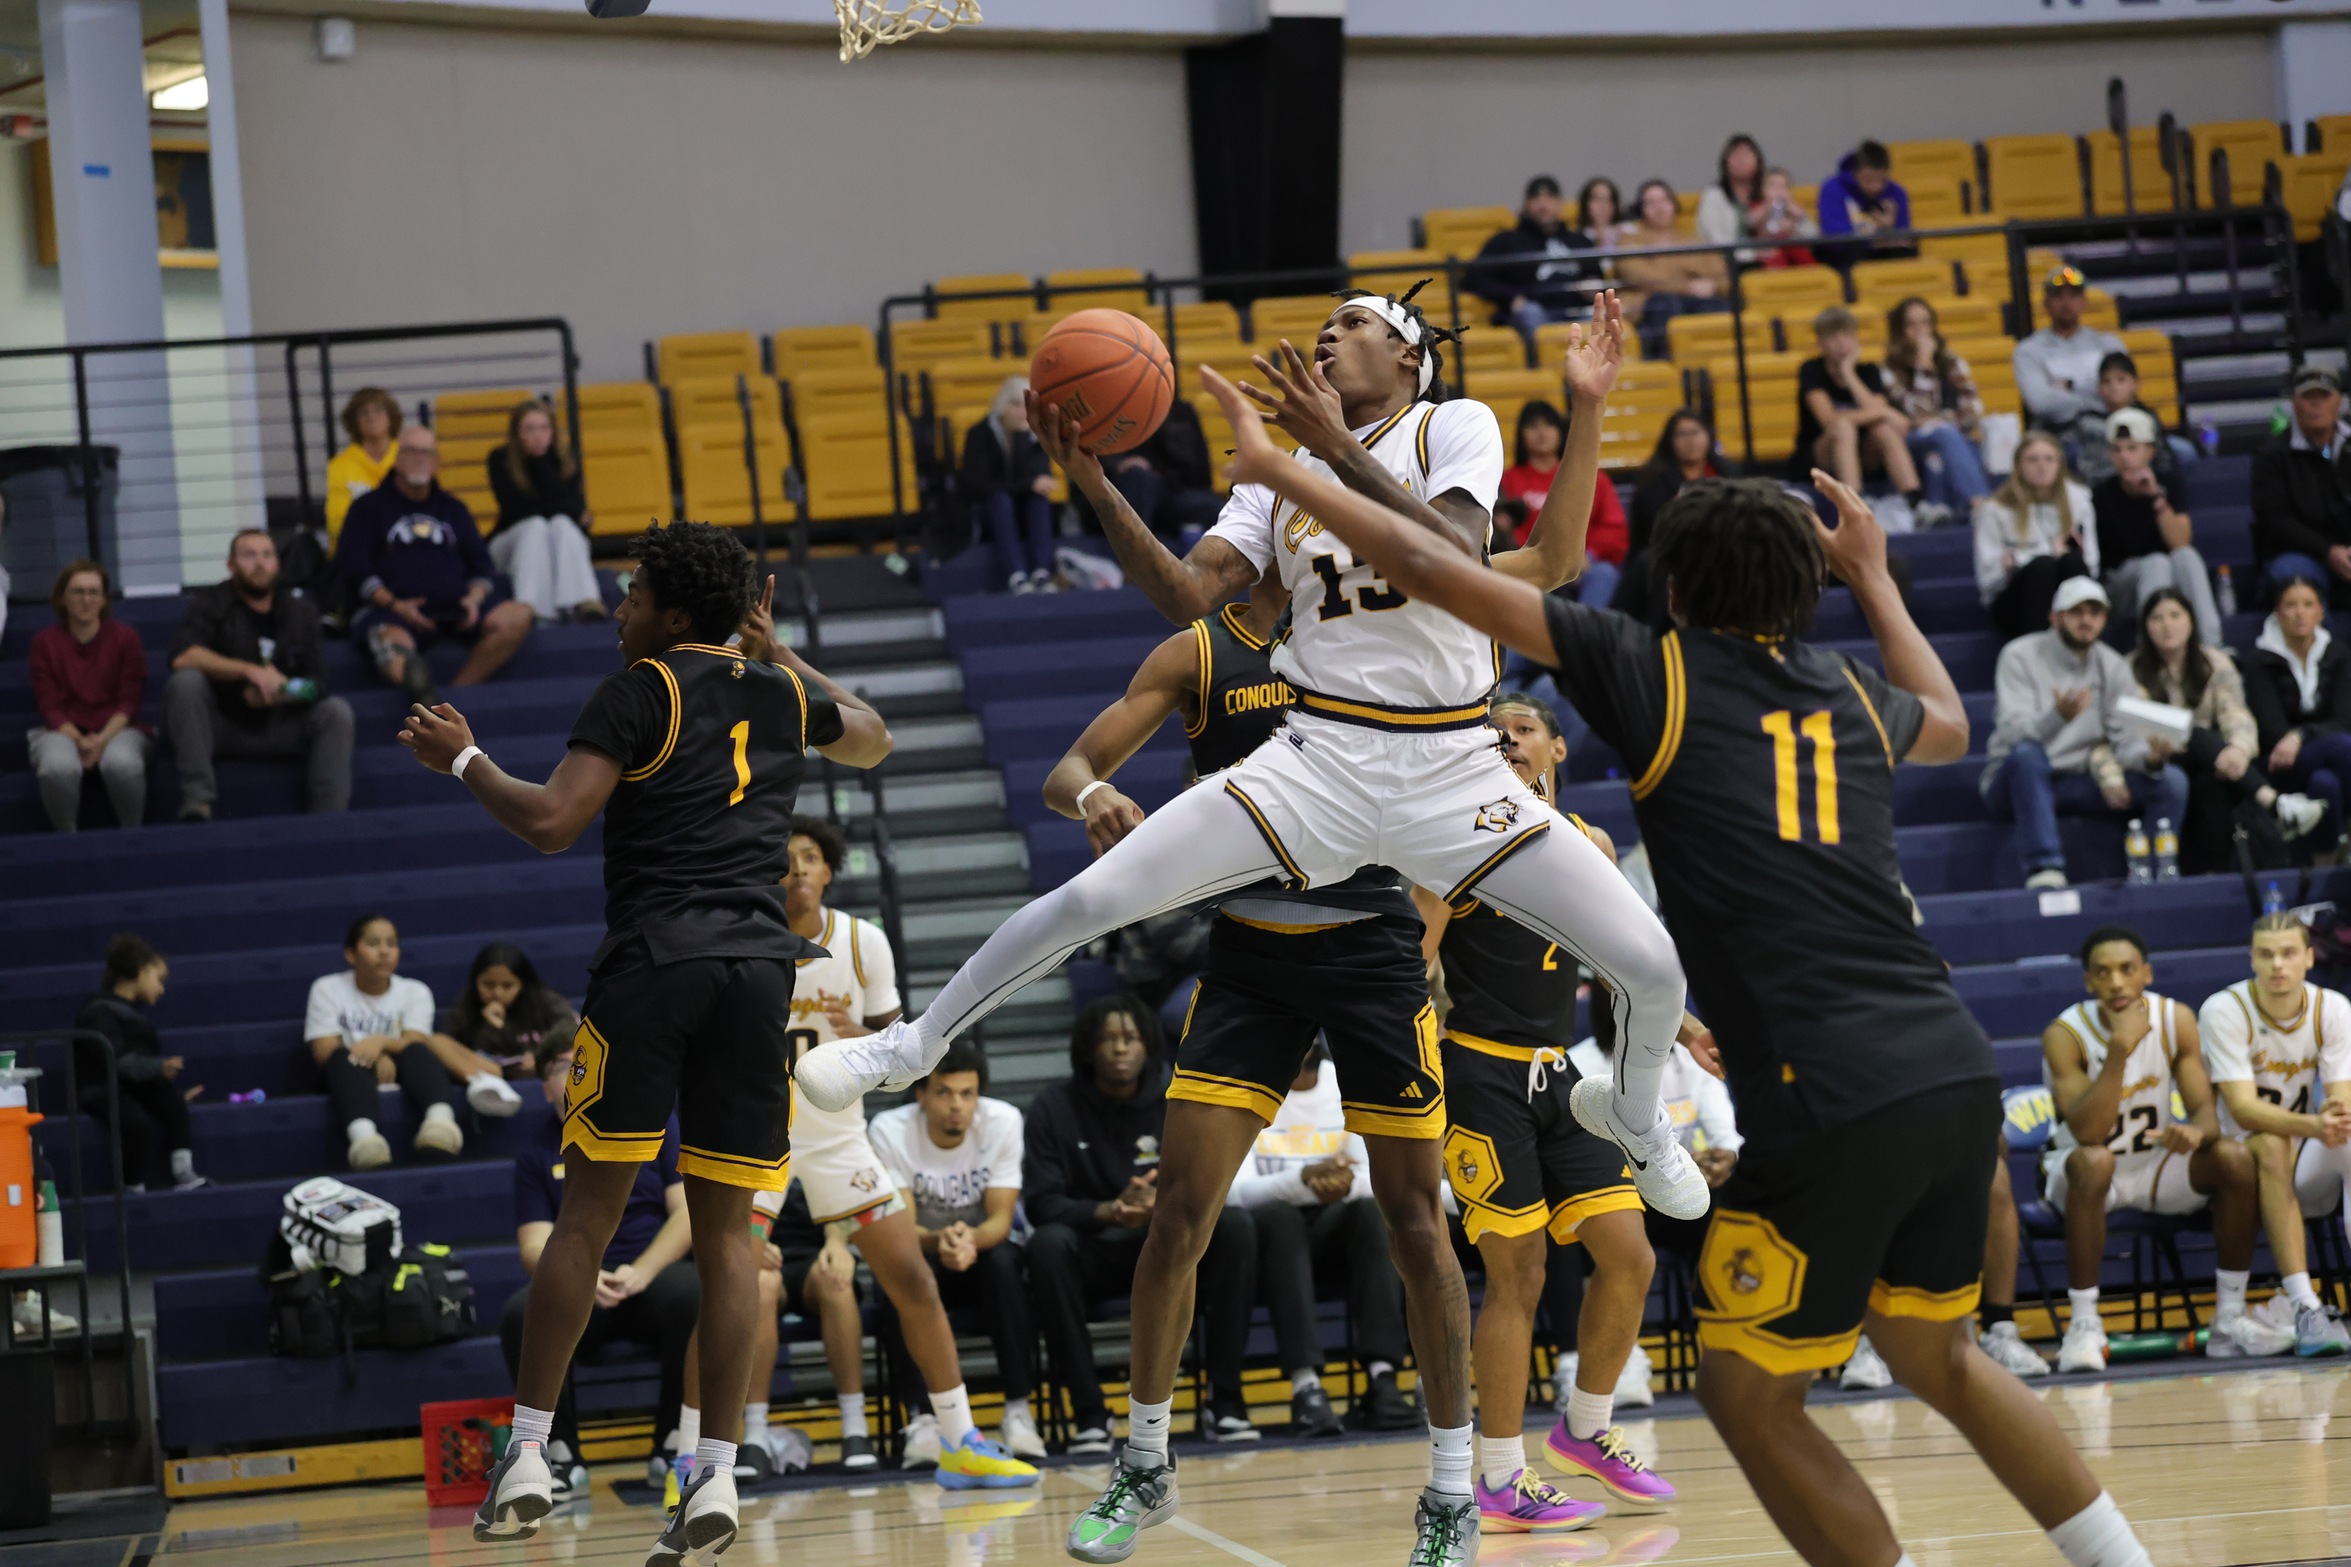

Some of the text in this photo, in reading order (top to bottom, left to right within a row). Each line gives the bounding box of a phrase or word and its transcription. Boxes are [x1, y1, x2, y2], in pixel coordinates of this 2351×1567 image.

[729, 720, 752, 808] 1
[1760, 710, 1841, 846] 11
[913, 1167, 991, 1203] COUGARS
